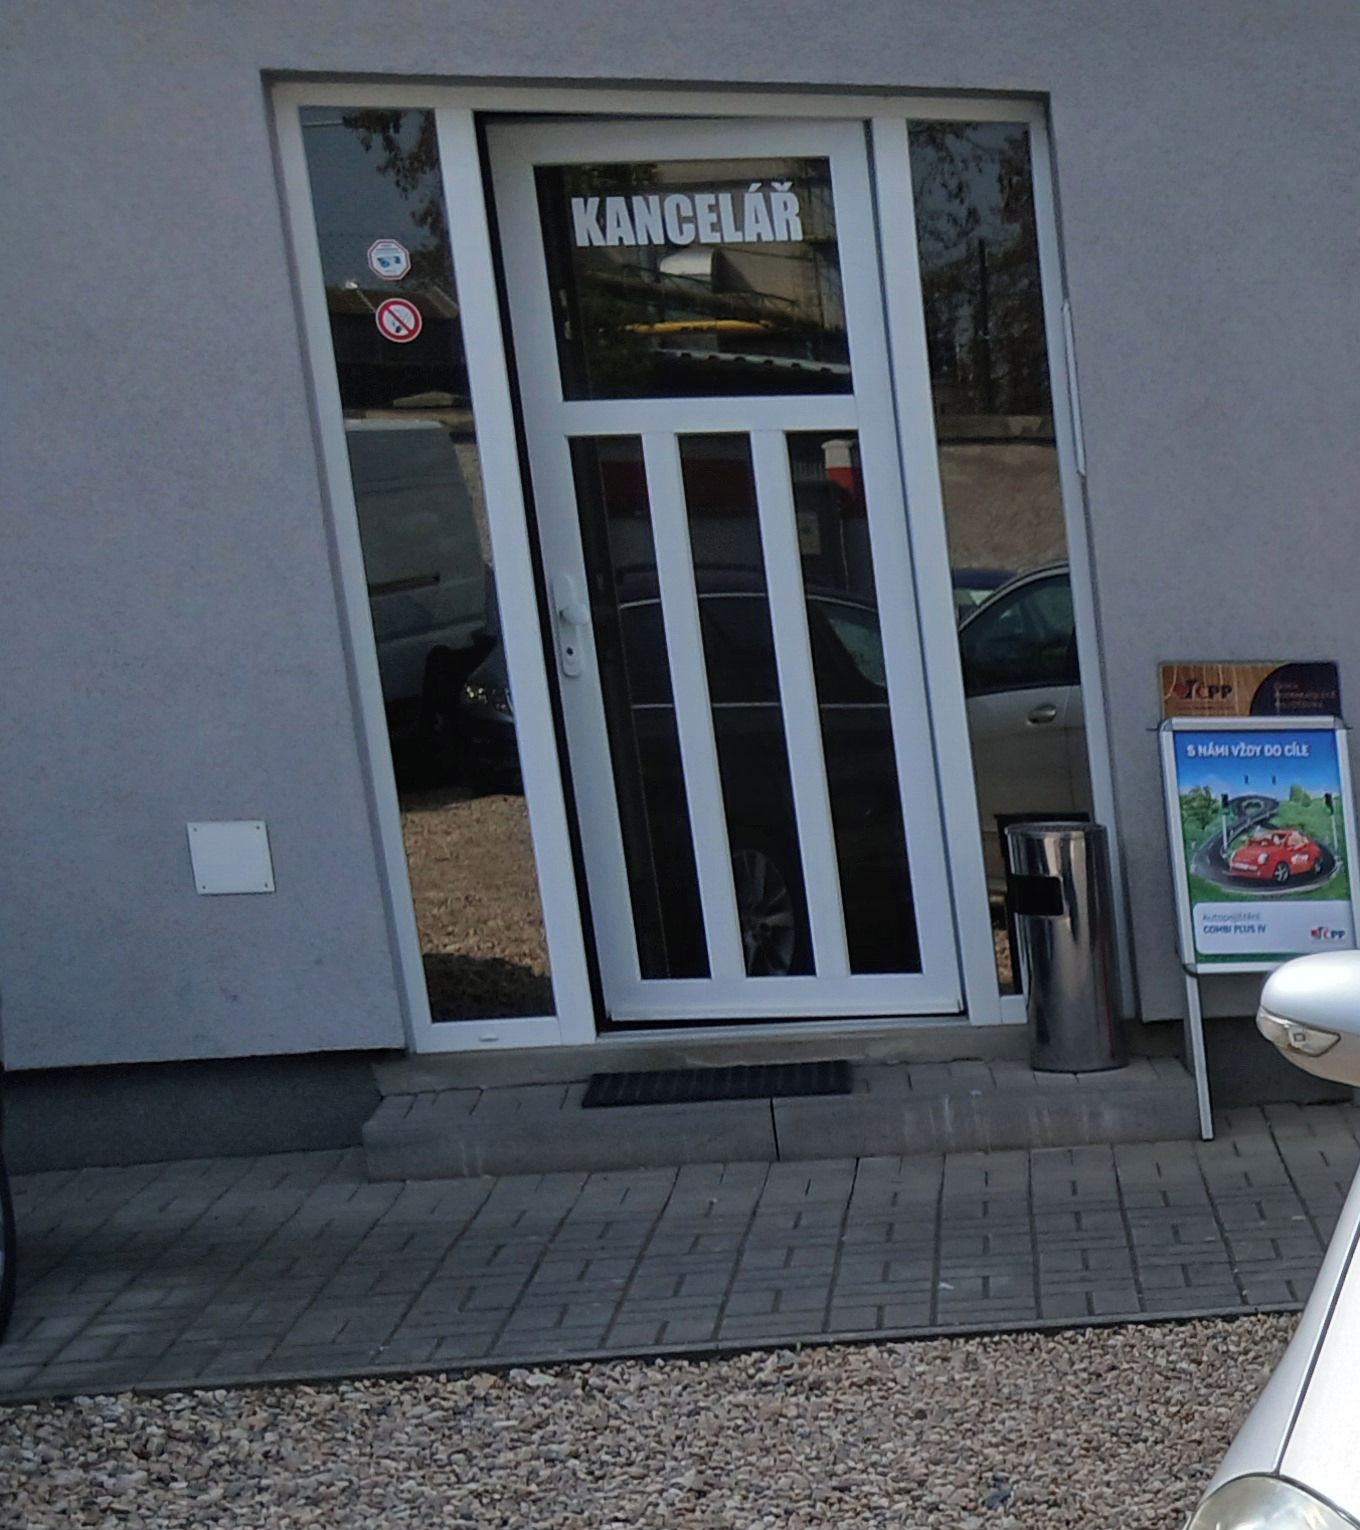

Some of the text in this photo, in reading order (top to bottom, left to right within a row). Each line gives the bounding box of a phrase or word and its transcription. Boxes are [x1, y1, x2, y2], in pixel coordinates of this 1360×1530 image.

[571, 181, 803, 247] KANCELÁŘ
[1198, 742, 1229, 757] NÁMI
[1231, 742, 1261, 757] VŽDY
[1264, 744, 1282, 757] DO
[1284, 742, 1310, 757] CÍLE
[1233, 924, 1256, 934] PLUS
